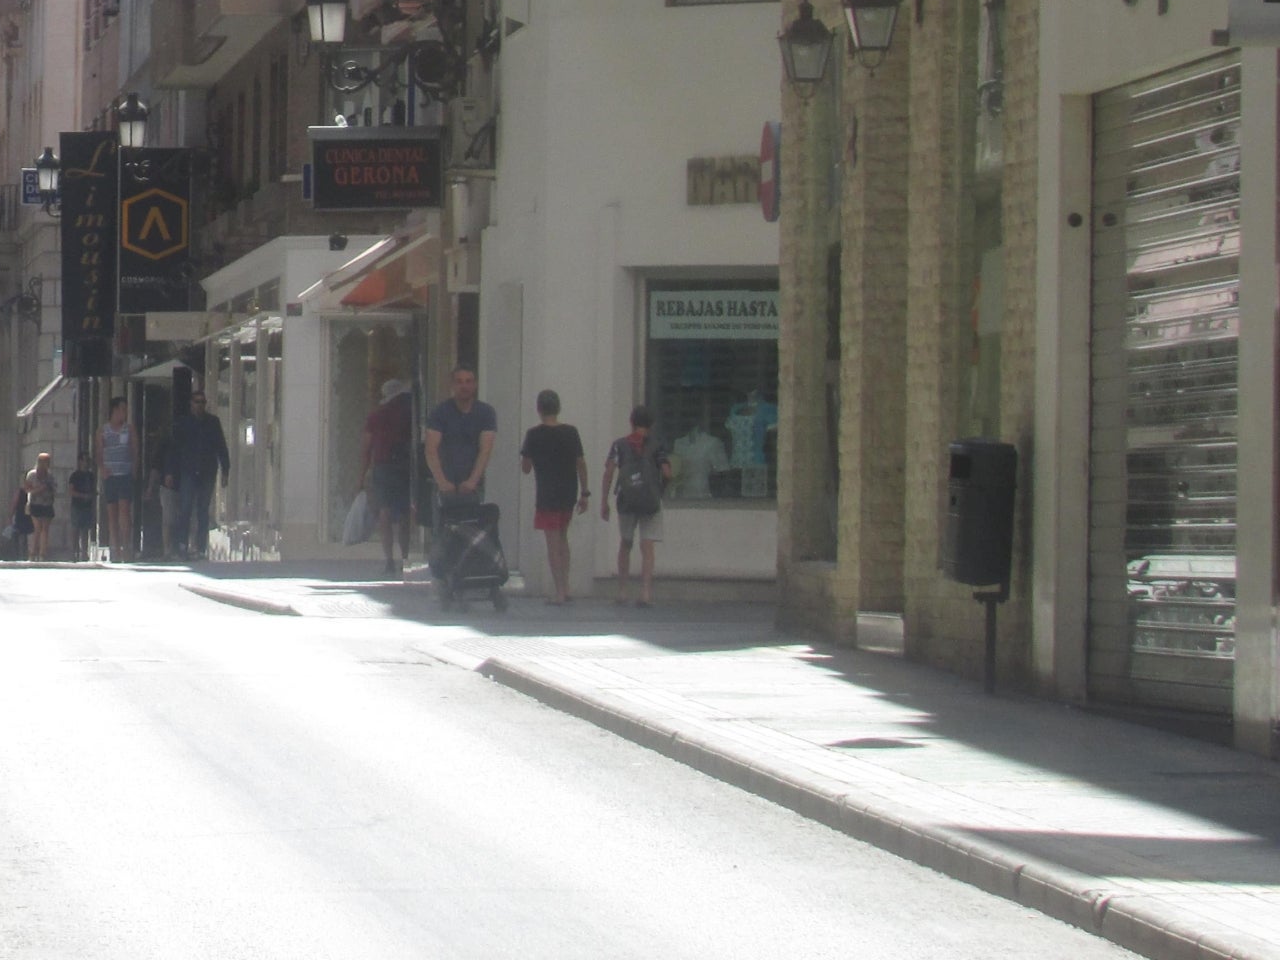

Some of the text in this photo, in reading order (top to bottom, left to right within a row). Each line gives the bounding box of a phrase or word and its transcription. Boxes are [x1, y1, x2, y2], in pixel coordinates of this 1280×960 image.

[334, 165, 420, 186] GERONA
[656, 300, 778, 317] REBAJAS HASTA
